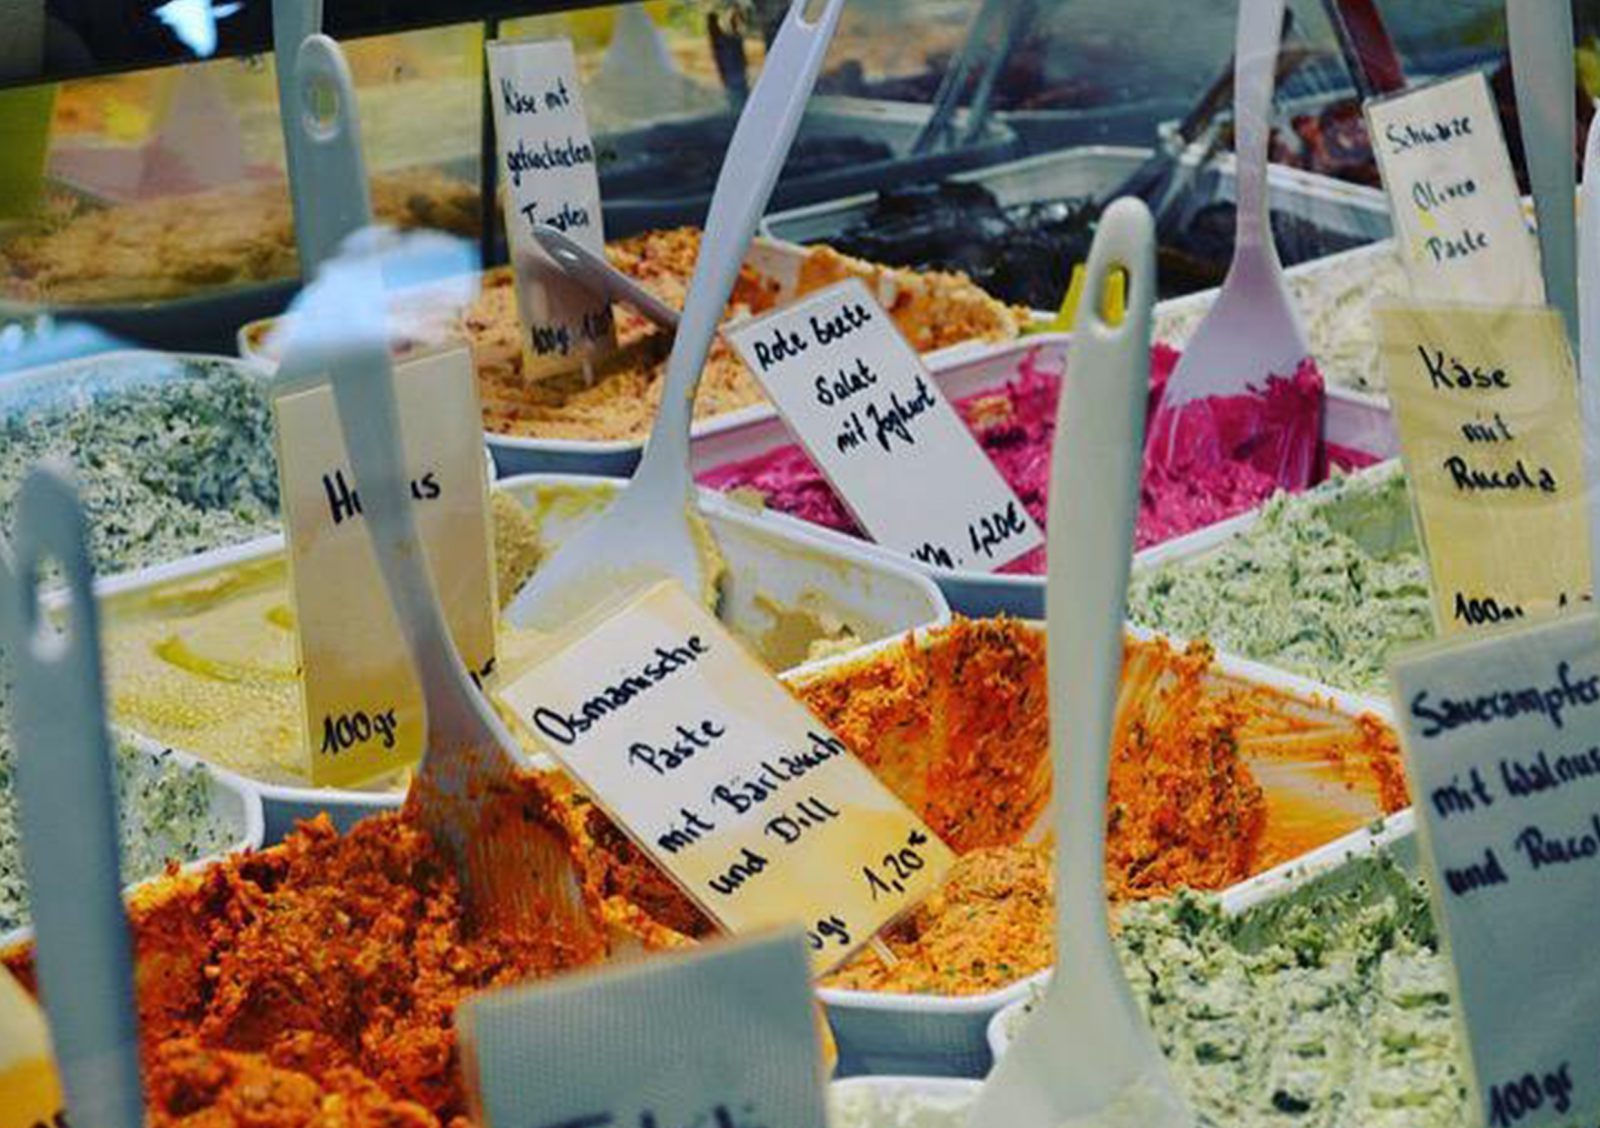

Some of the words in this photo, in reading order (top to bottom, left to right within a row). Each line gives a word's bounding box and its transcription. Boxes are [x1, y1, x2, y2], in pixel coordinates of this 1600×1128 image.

[754, 328, 808, 371] Rote
[1418, 344, 1511, 388] Käse
[814, 357, 877, 405] Salat
[836, 411, 868, 453] mit
[1443, 455, 1556, 493] Rucola
[532, 635, 709, 745] Osmanische
[321, 706, 397, 754] 100gr
[628, 720, 726, 775] Paste
[1431, 766, 1495, 819] mit
[658, 807, 715, 853] mit
[708, 848, 769, 895] und
[764, 797, 840, 845] Dill
[1444, 848, 1509, 896] und
[1488, 1060, 1573, 1128] 100gr
